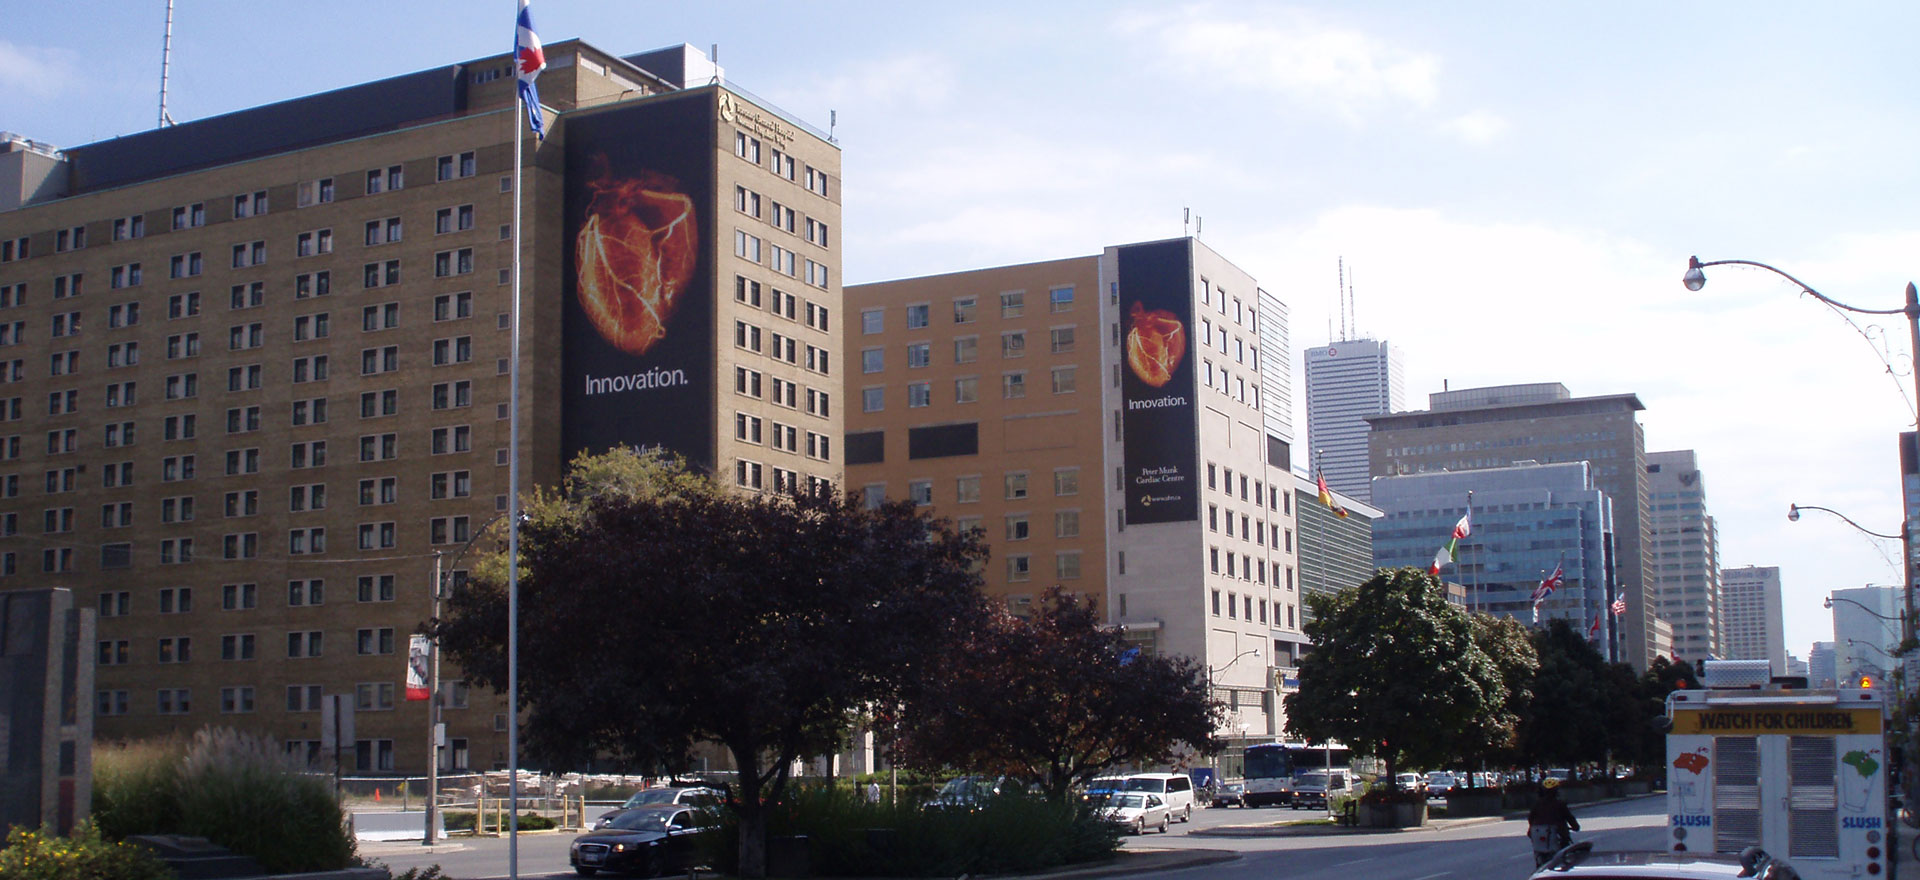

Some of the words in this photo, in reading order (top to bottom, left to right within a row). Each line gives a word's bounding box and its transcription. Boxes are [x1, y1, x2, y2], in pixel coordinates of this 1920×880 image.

[585, 366, 688, 395] Innovation.
[1129, 395, 1187, 409] Innovation.
[1142, 467, 1158, 476] Peter
[1159, 465, 1178, 475] Munk
[1136, 476, 1161, 484] Cardiac
[1162, 474, 1185, 482] Centre
[1699, 713, 1752, 729] WATCH
[1755, 713, 1784, 729] FOR
[1786, 713, 1853, 729] CHILDREN
[1672, 815, 1711, 826] SLUSH
[1842, 816, 1881, 828] SLUSH
